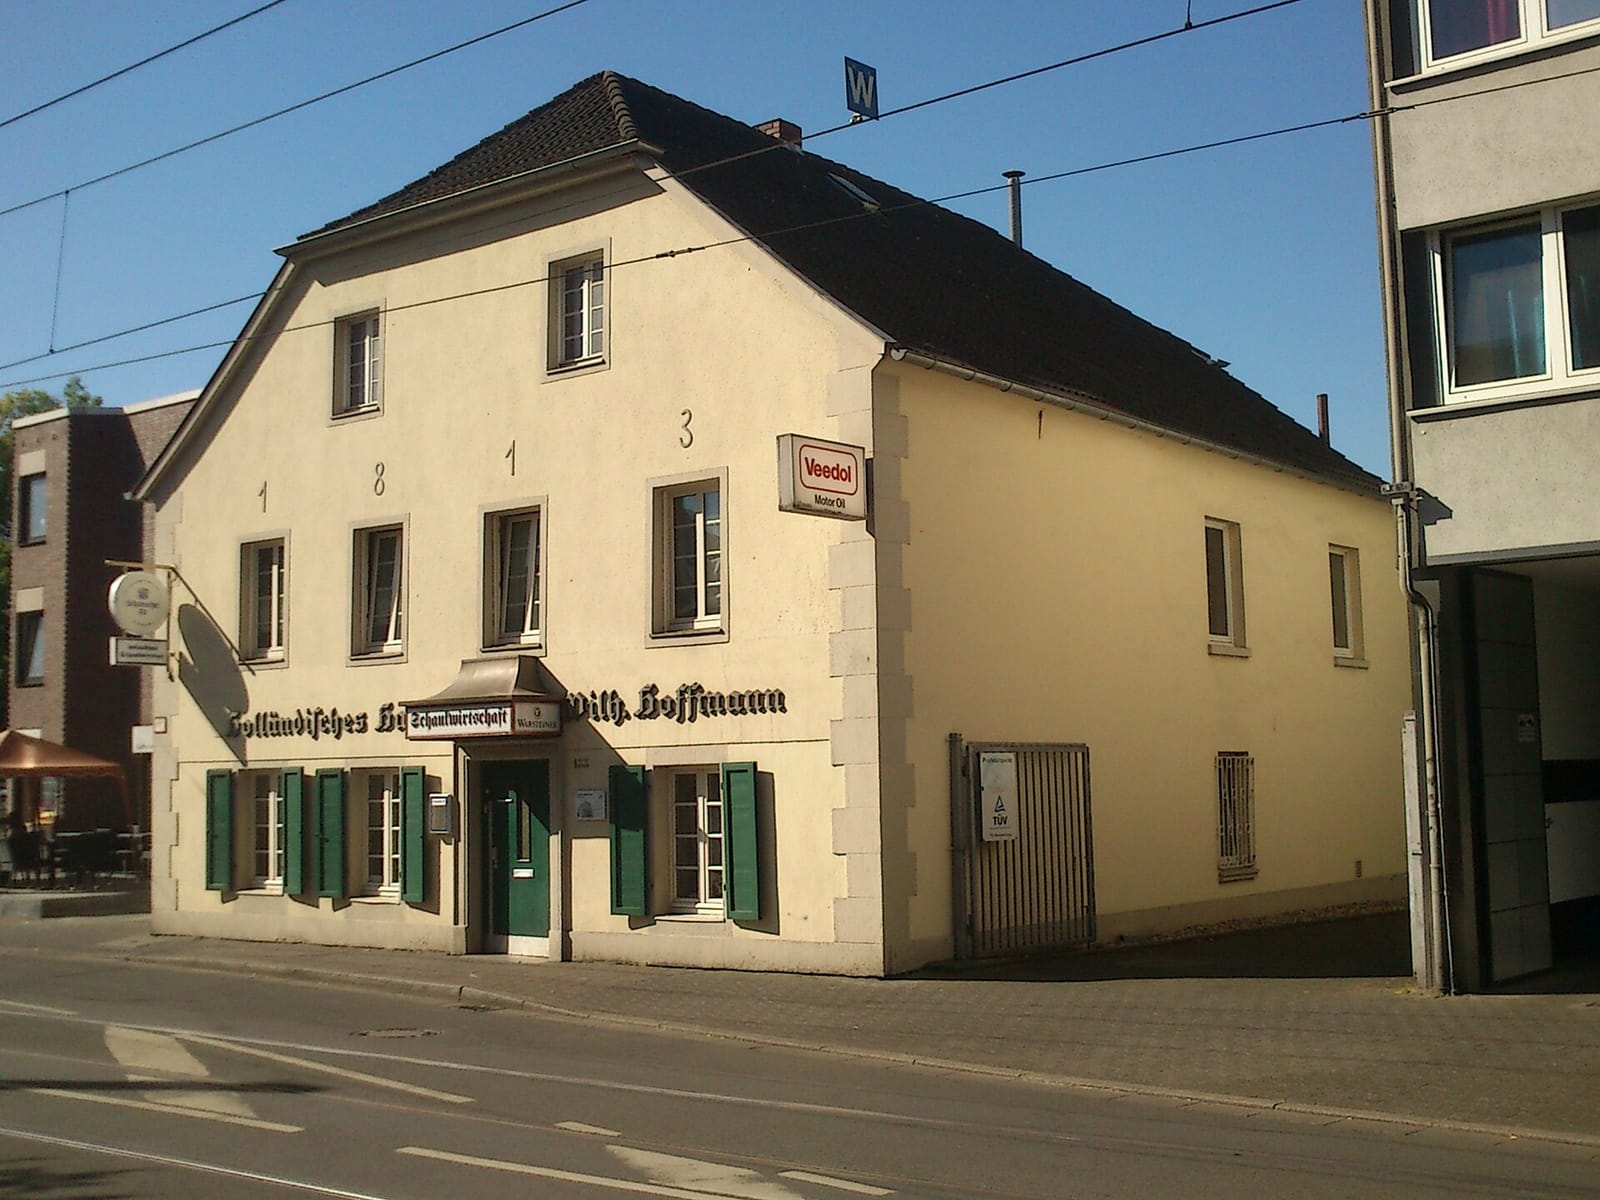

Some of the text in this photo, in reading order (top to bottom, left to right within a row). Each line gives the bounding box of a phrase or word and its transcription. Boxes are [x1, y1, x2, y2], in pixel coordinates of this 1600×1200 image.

[847, 64, 875, 109] W
[804, 456, 851, 482] Veedol
[814, 494, 846, 509] Motor Oil
[634, 682, 788, 724] Hoffmann
[410, 706, 508, 730] Schankwirtschaft
[992, 813, 1008, 826] TÜV
